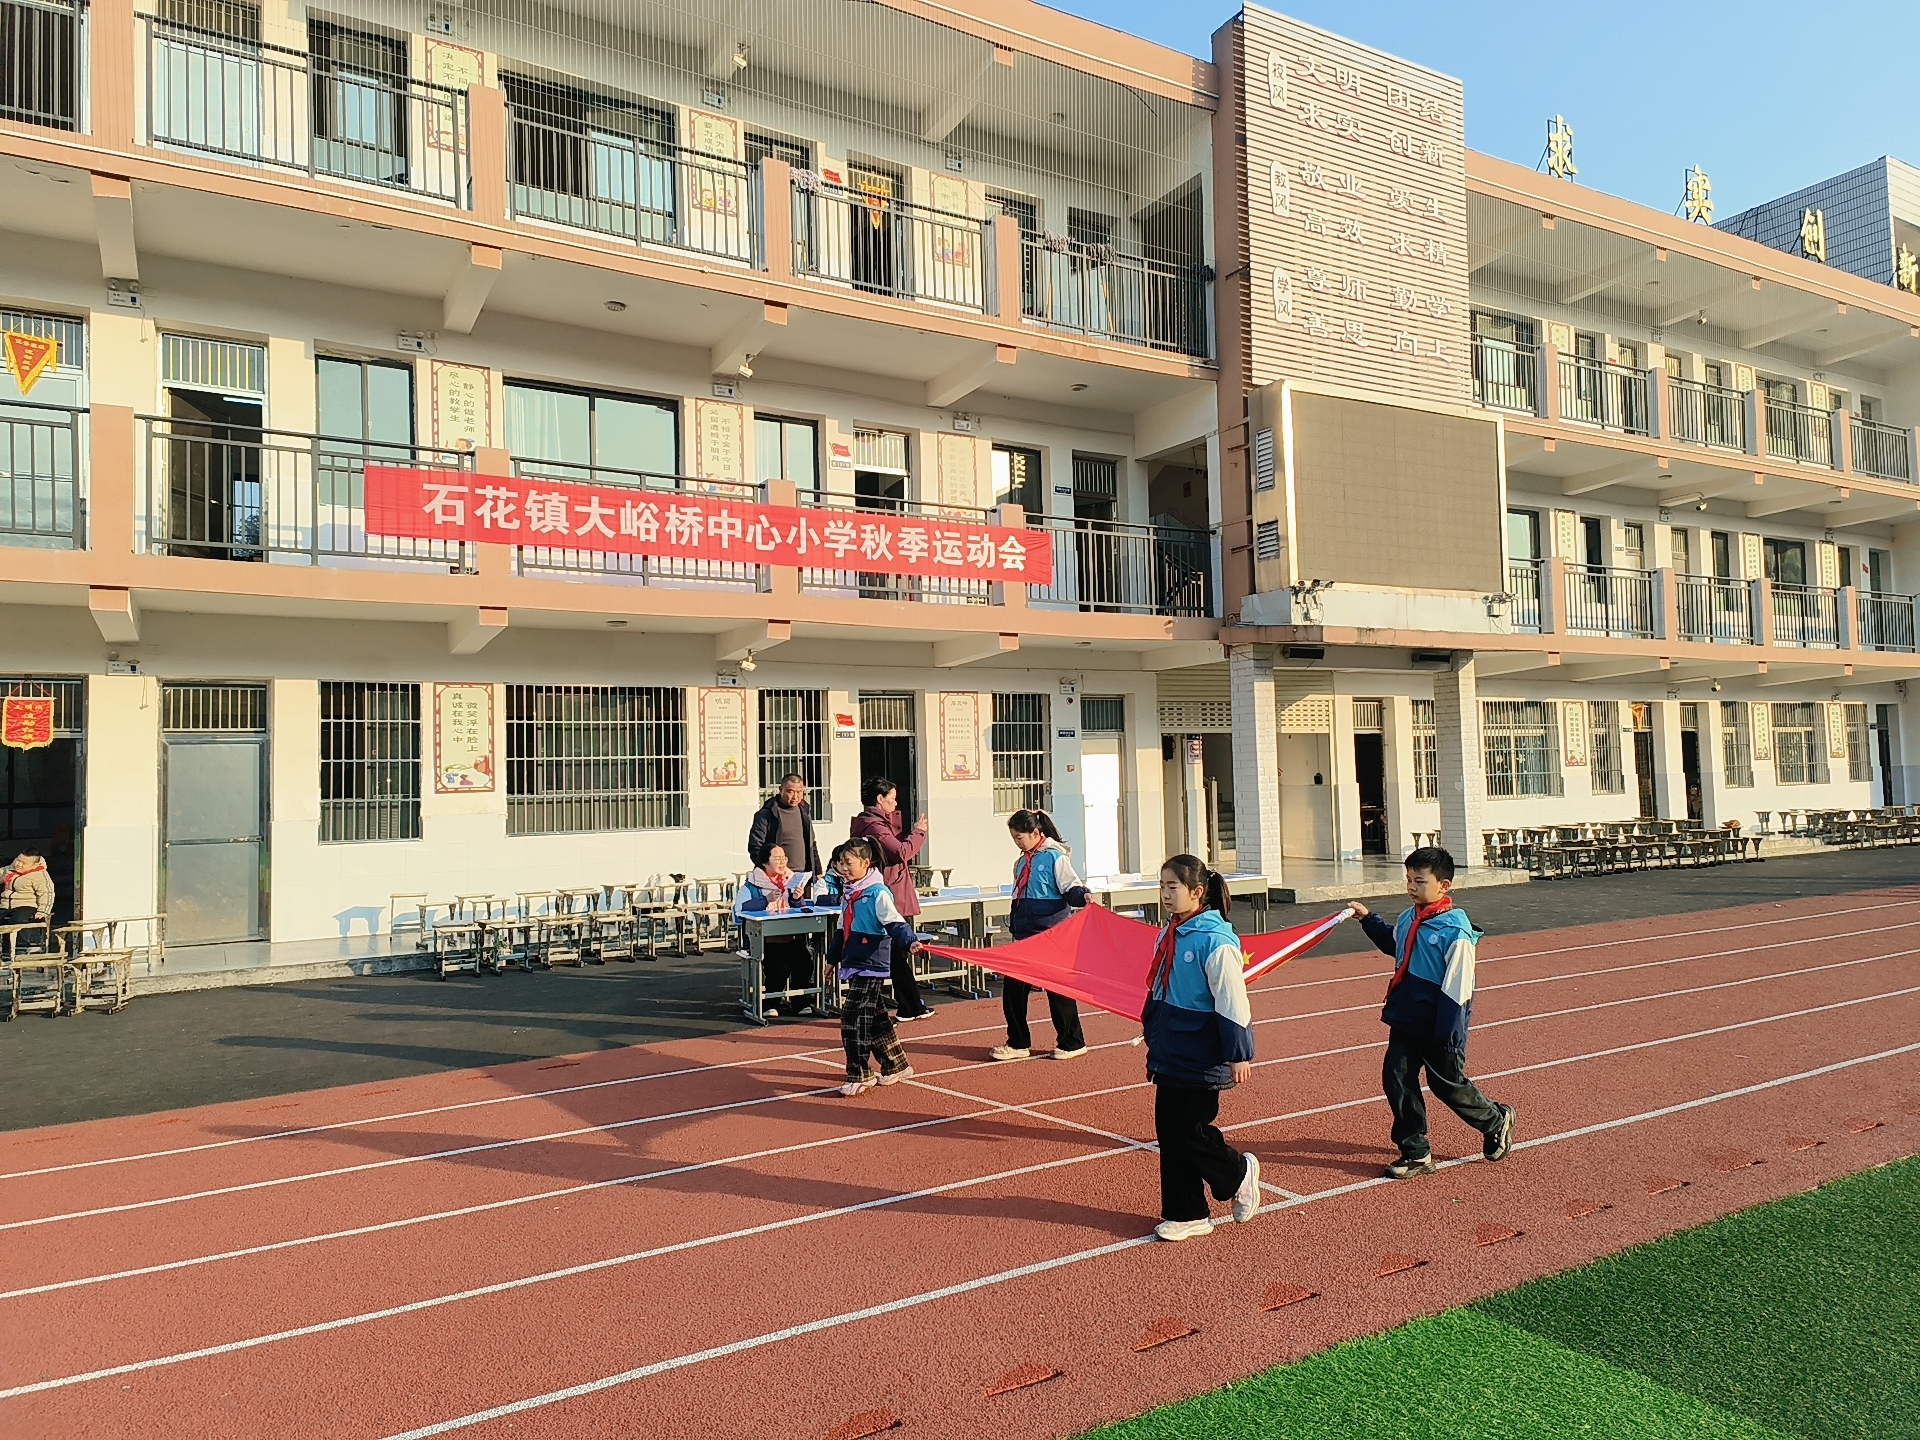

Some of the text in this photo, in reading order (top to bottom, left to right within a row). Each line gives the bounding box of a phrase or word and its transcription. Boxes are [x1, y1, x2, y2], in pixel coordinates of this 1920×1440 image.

[1271, 60, 1287, 103] 校风
[1296, 55, 1445, 124] 文明 团结
[1297, 103, 1445, 167] 求实 创新
[1273, 168, 1289, 210] 教风
[1299, 162, 1449, 223] 敬业 爱生
[1301, 209, 1448, 267] 高效 求精
[1275, 275, 1291, 317] 学风
[1302, 266, 1451, 319] 尊师 勤学
[1304, 313, 1453, 363] 善思 向上
[463, 382, 476, 433] 静心的做老师
[422, 483, 1027, 572] 石花镇大峪桥中心小学秋季运动会
[452, 692, 463, 743] 真诚在我心中
[466, 701, 479, 752] 微笑浮在脸上
